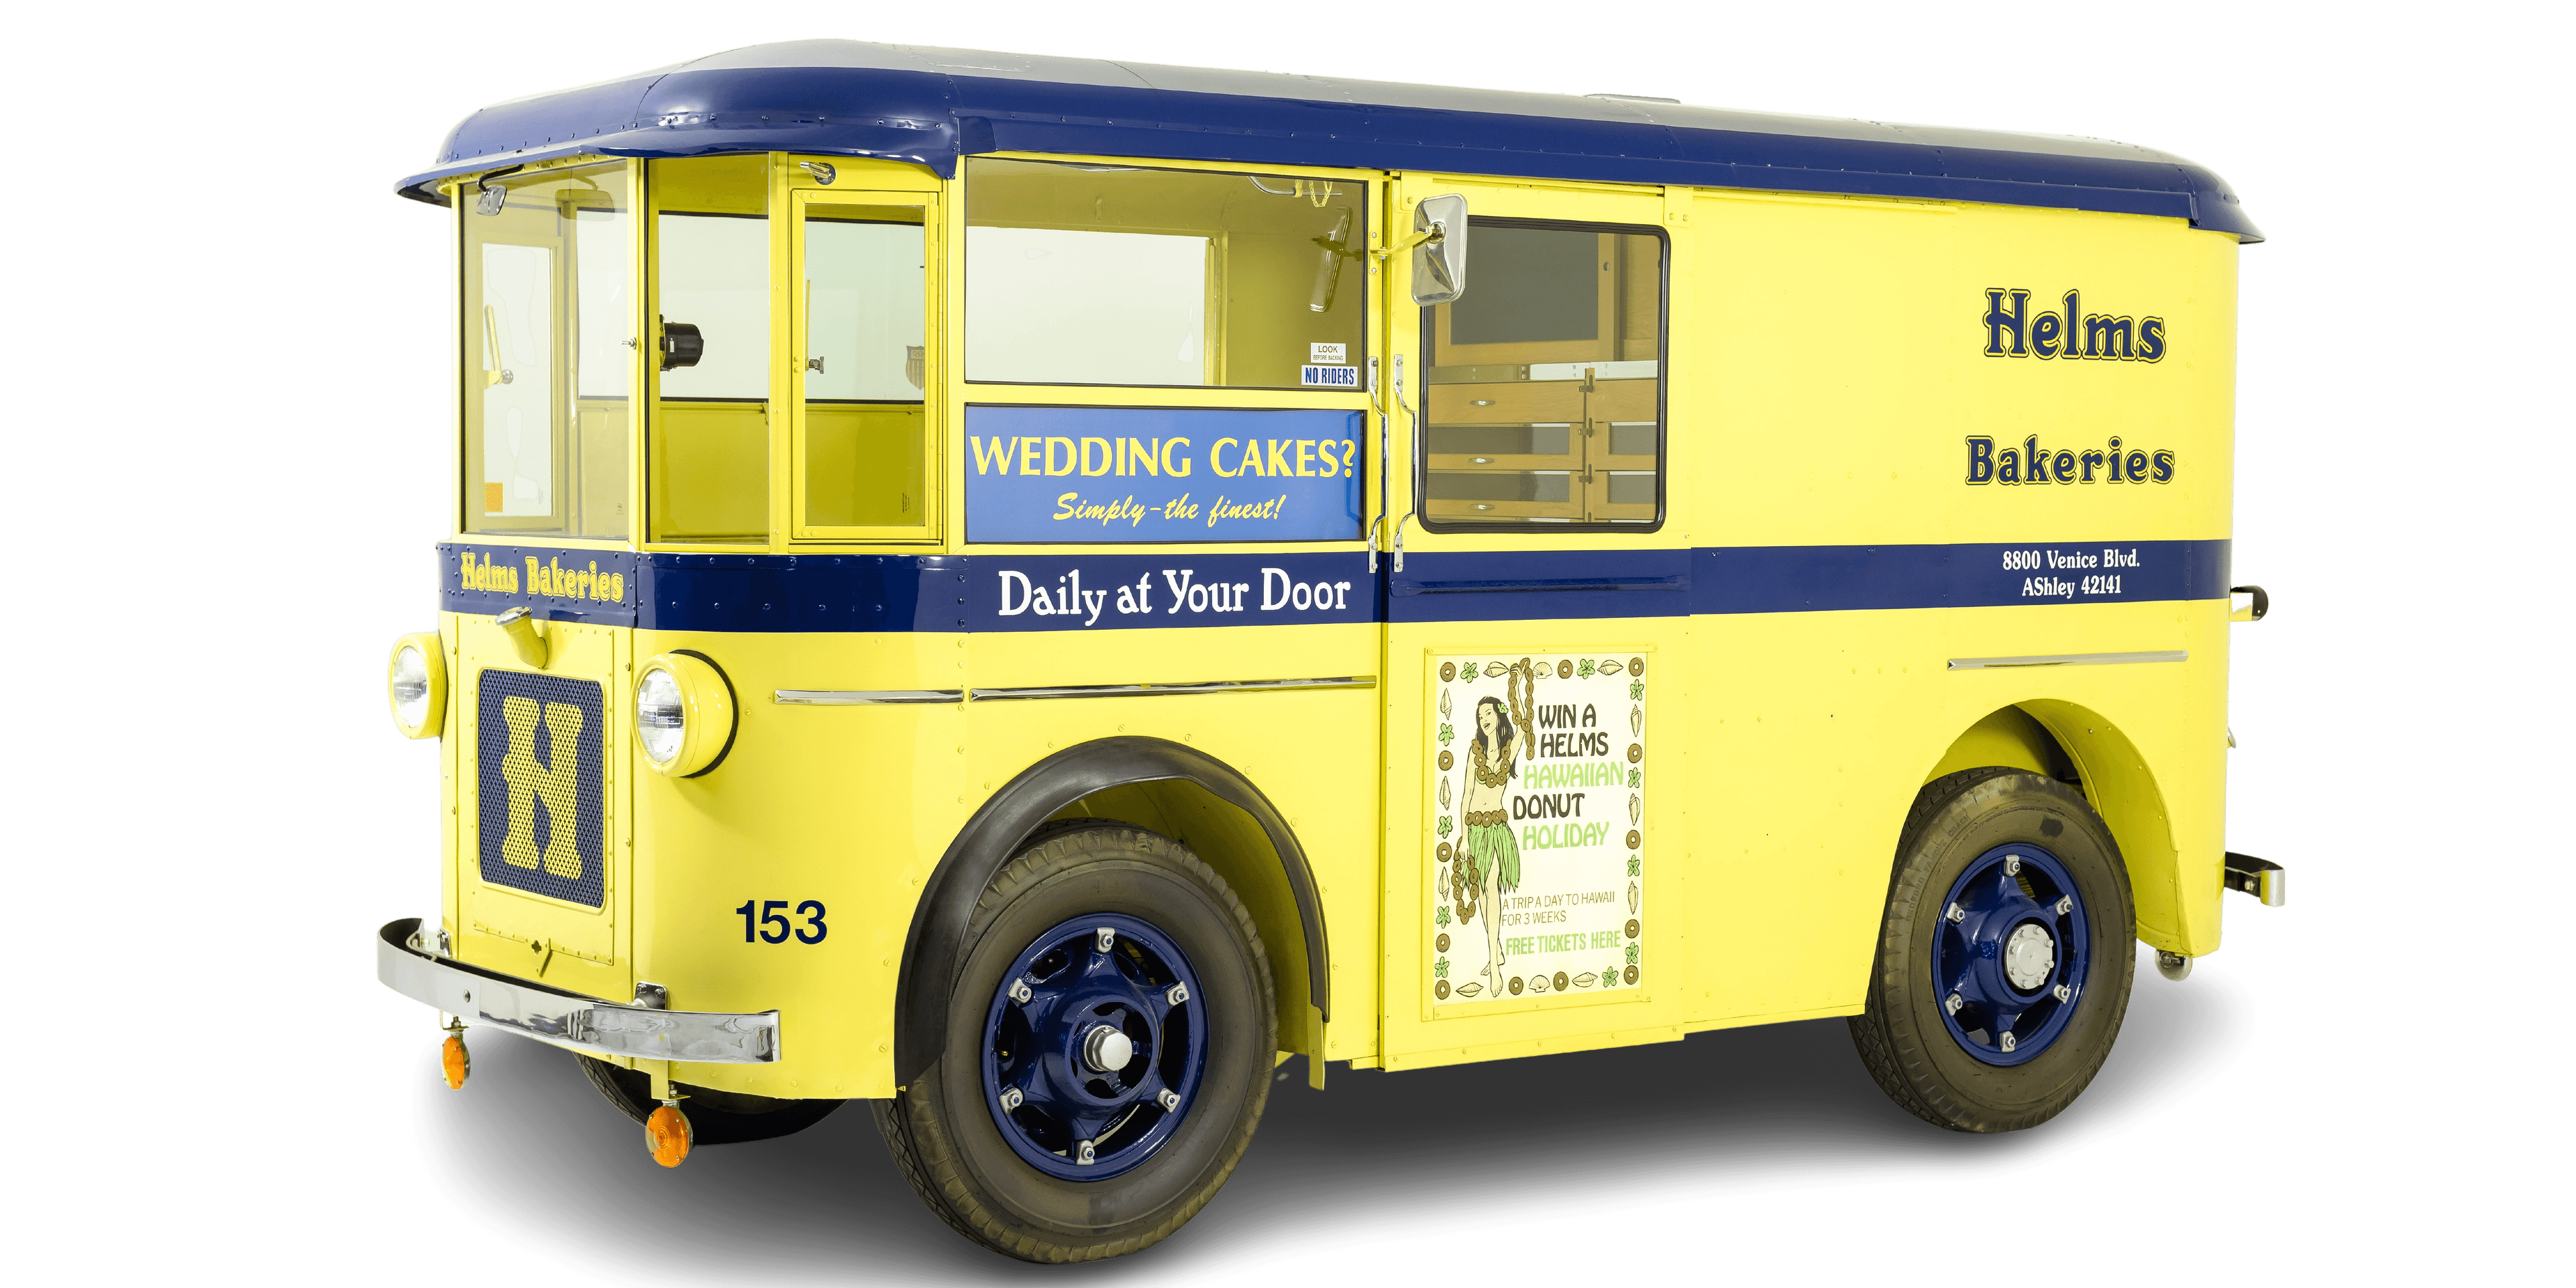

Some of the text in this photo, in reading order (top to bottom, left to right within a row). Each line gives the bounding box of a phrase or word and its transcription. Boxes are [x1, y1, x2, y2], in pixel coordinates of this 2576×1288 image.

[1982, 287, 2167, 364] Helms
[1305, 367, 1354, 385] NO RIDERS
[971, 436, 1356, 478] WEDDING CAKES?
[1965, 433, 2176, 486] Bakeries
[1207, 494, 1287, 528] finest!
[2002, 548, 2141, 570] 8800 Venice Blvd.
[460, 552, 625, 602] Helms Bakeries
[2021, 574, 2122, 599] AShley 42141
[998, 567, 1351, 627] Daily at Your Door
[1538, 703, 1597, 730] WIN A
[1540, 732, 1609, 758] HELMS
[1523, 761, 1624, 790] HAWAIIAN
[1513, 792, 1585, 820] DONUT
[1522, 821, 1610, 851] HOLIDAY
[1502, 891, 1615, 910] A TRIP A DAY TO HAWAII
[736, 900, 828, 945] 153
[1501, 910, 1566, 926] FOR 3 WEEKS
[1505, 930, 1621, 956] FREE TICKETS HERE
